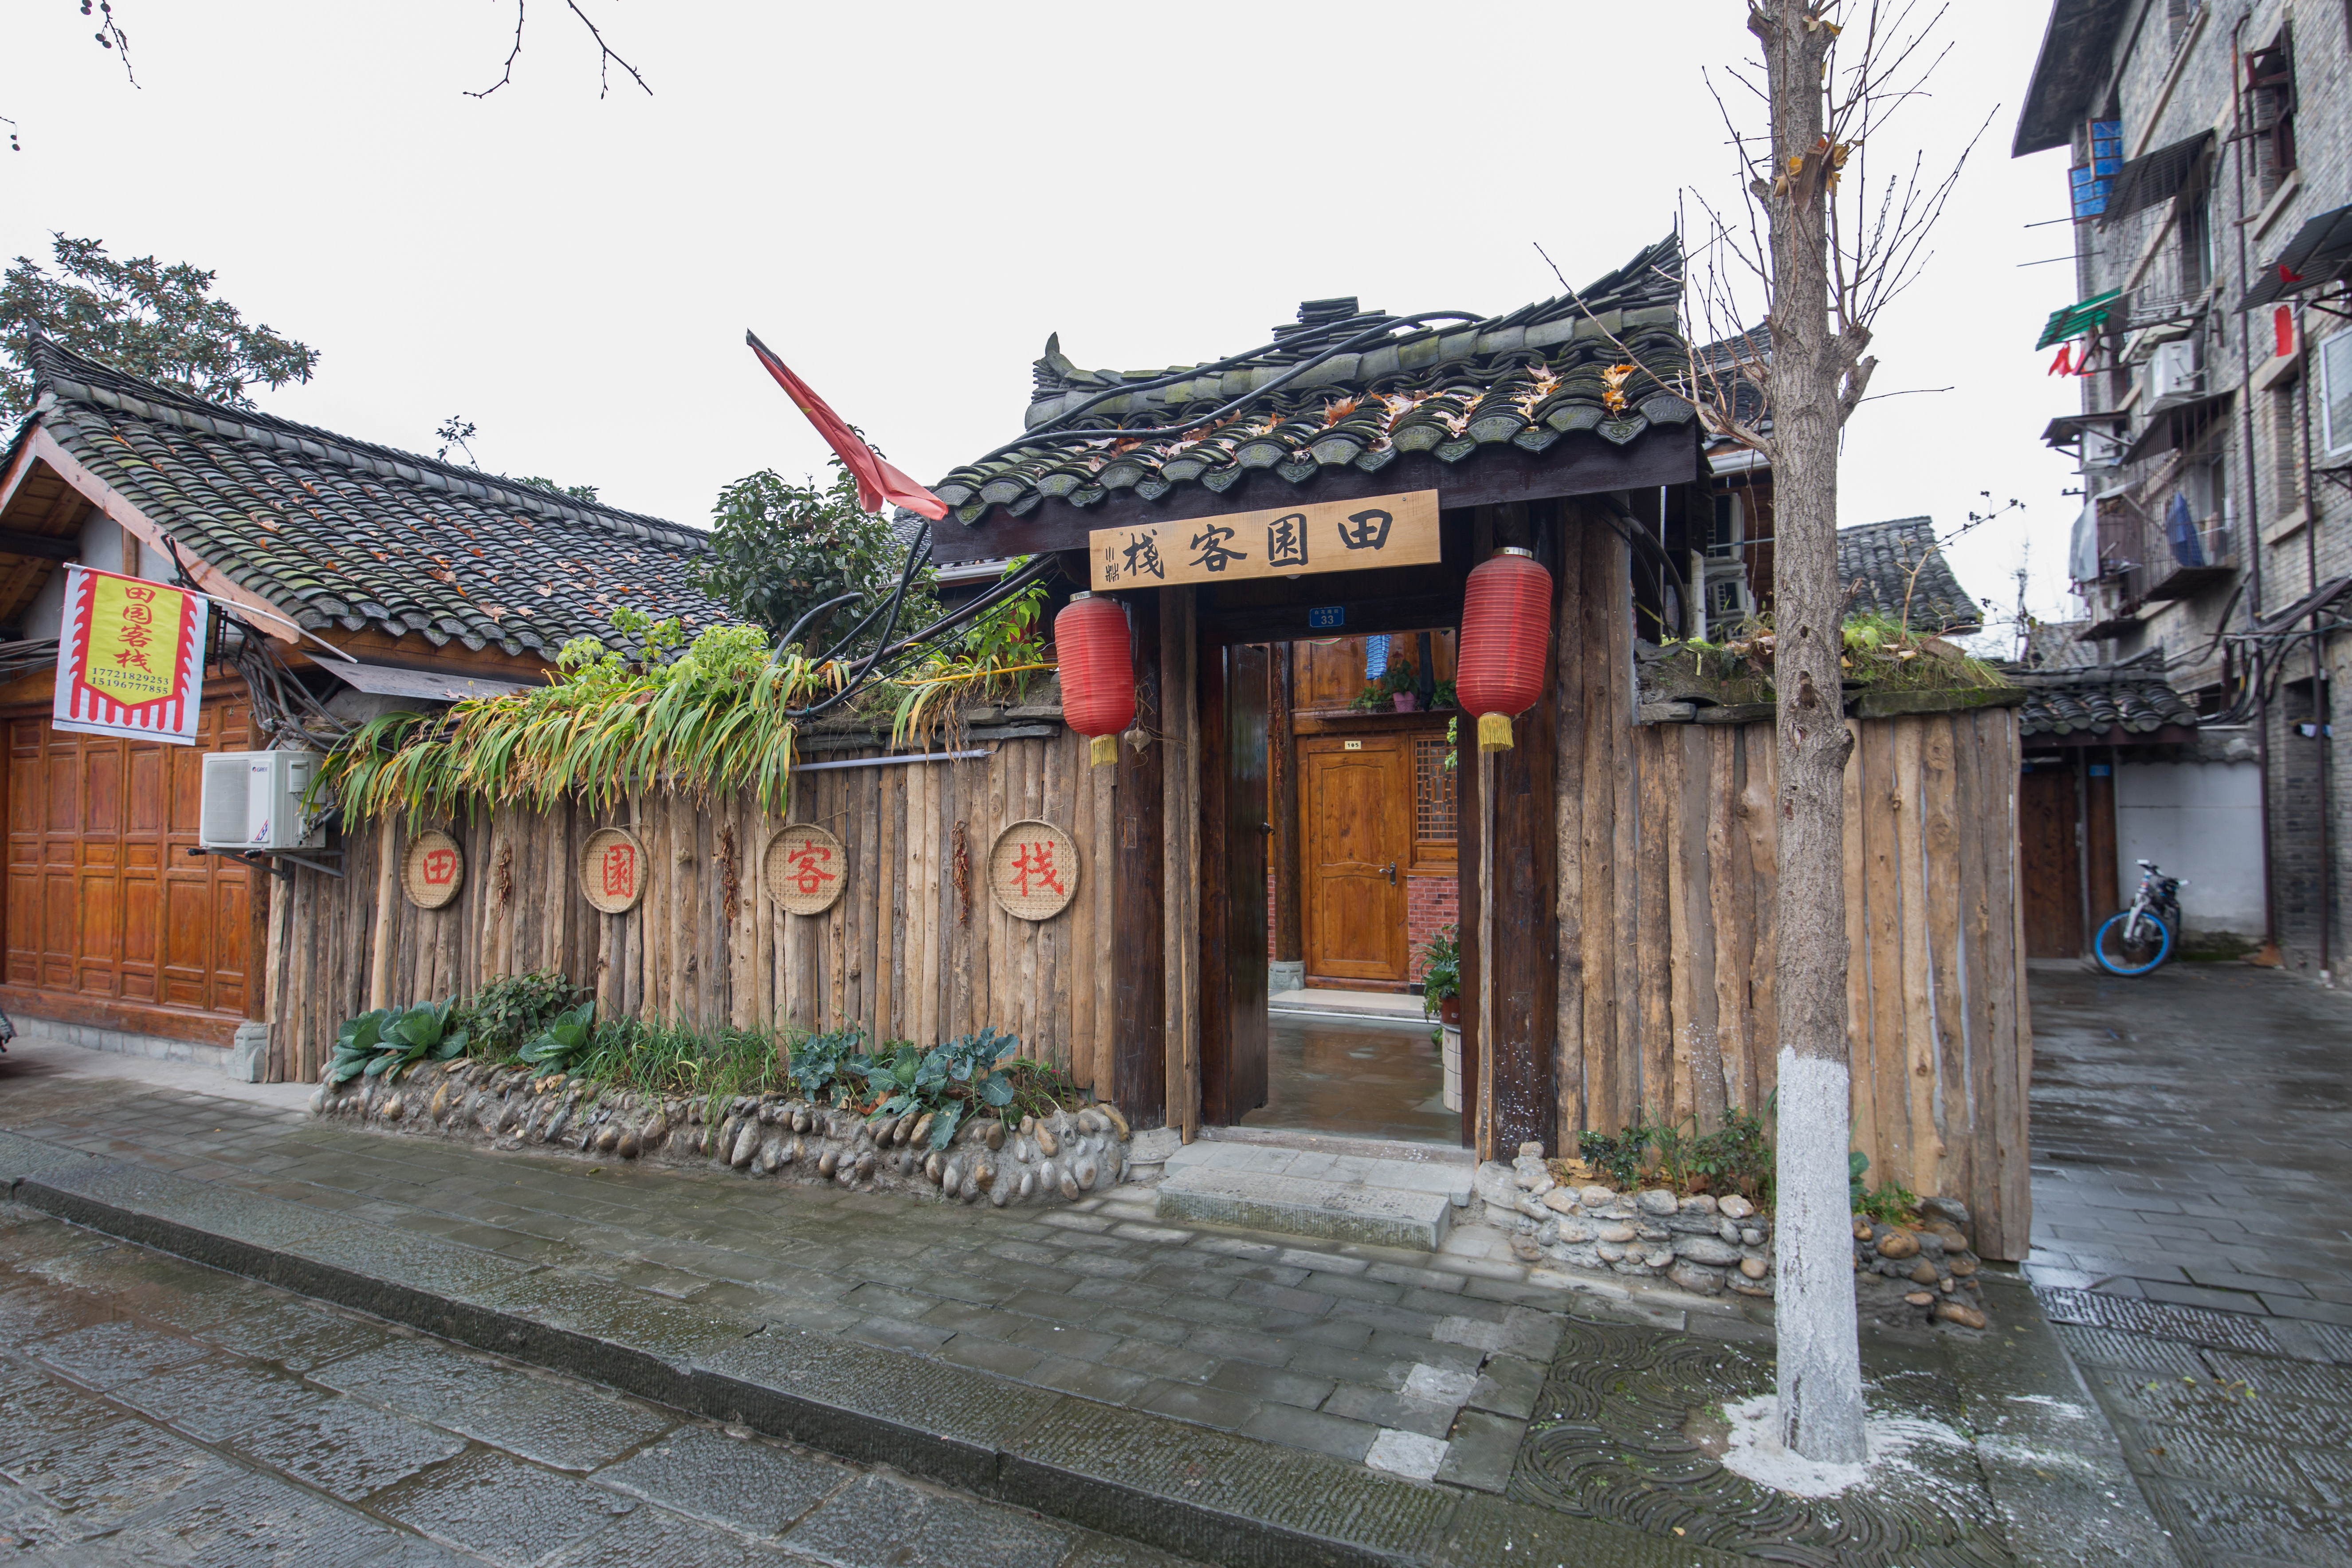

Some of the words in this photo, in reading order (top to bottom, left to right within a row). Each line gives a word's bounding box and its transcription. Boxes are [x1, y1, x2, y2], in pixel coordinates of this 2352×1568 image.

[1321, 615, 1334, 625] 33
[92, 667, 169, 685] 17721829253
[91, 677, 168, 695] 15196777855
[423, 849, 457, 885] 田
[785, 840, 836, 894] 客
